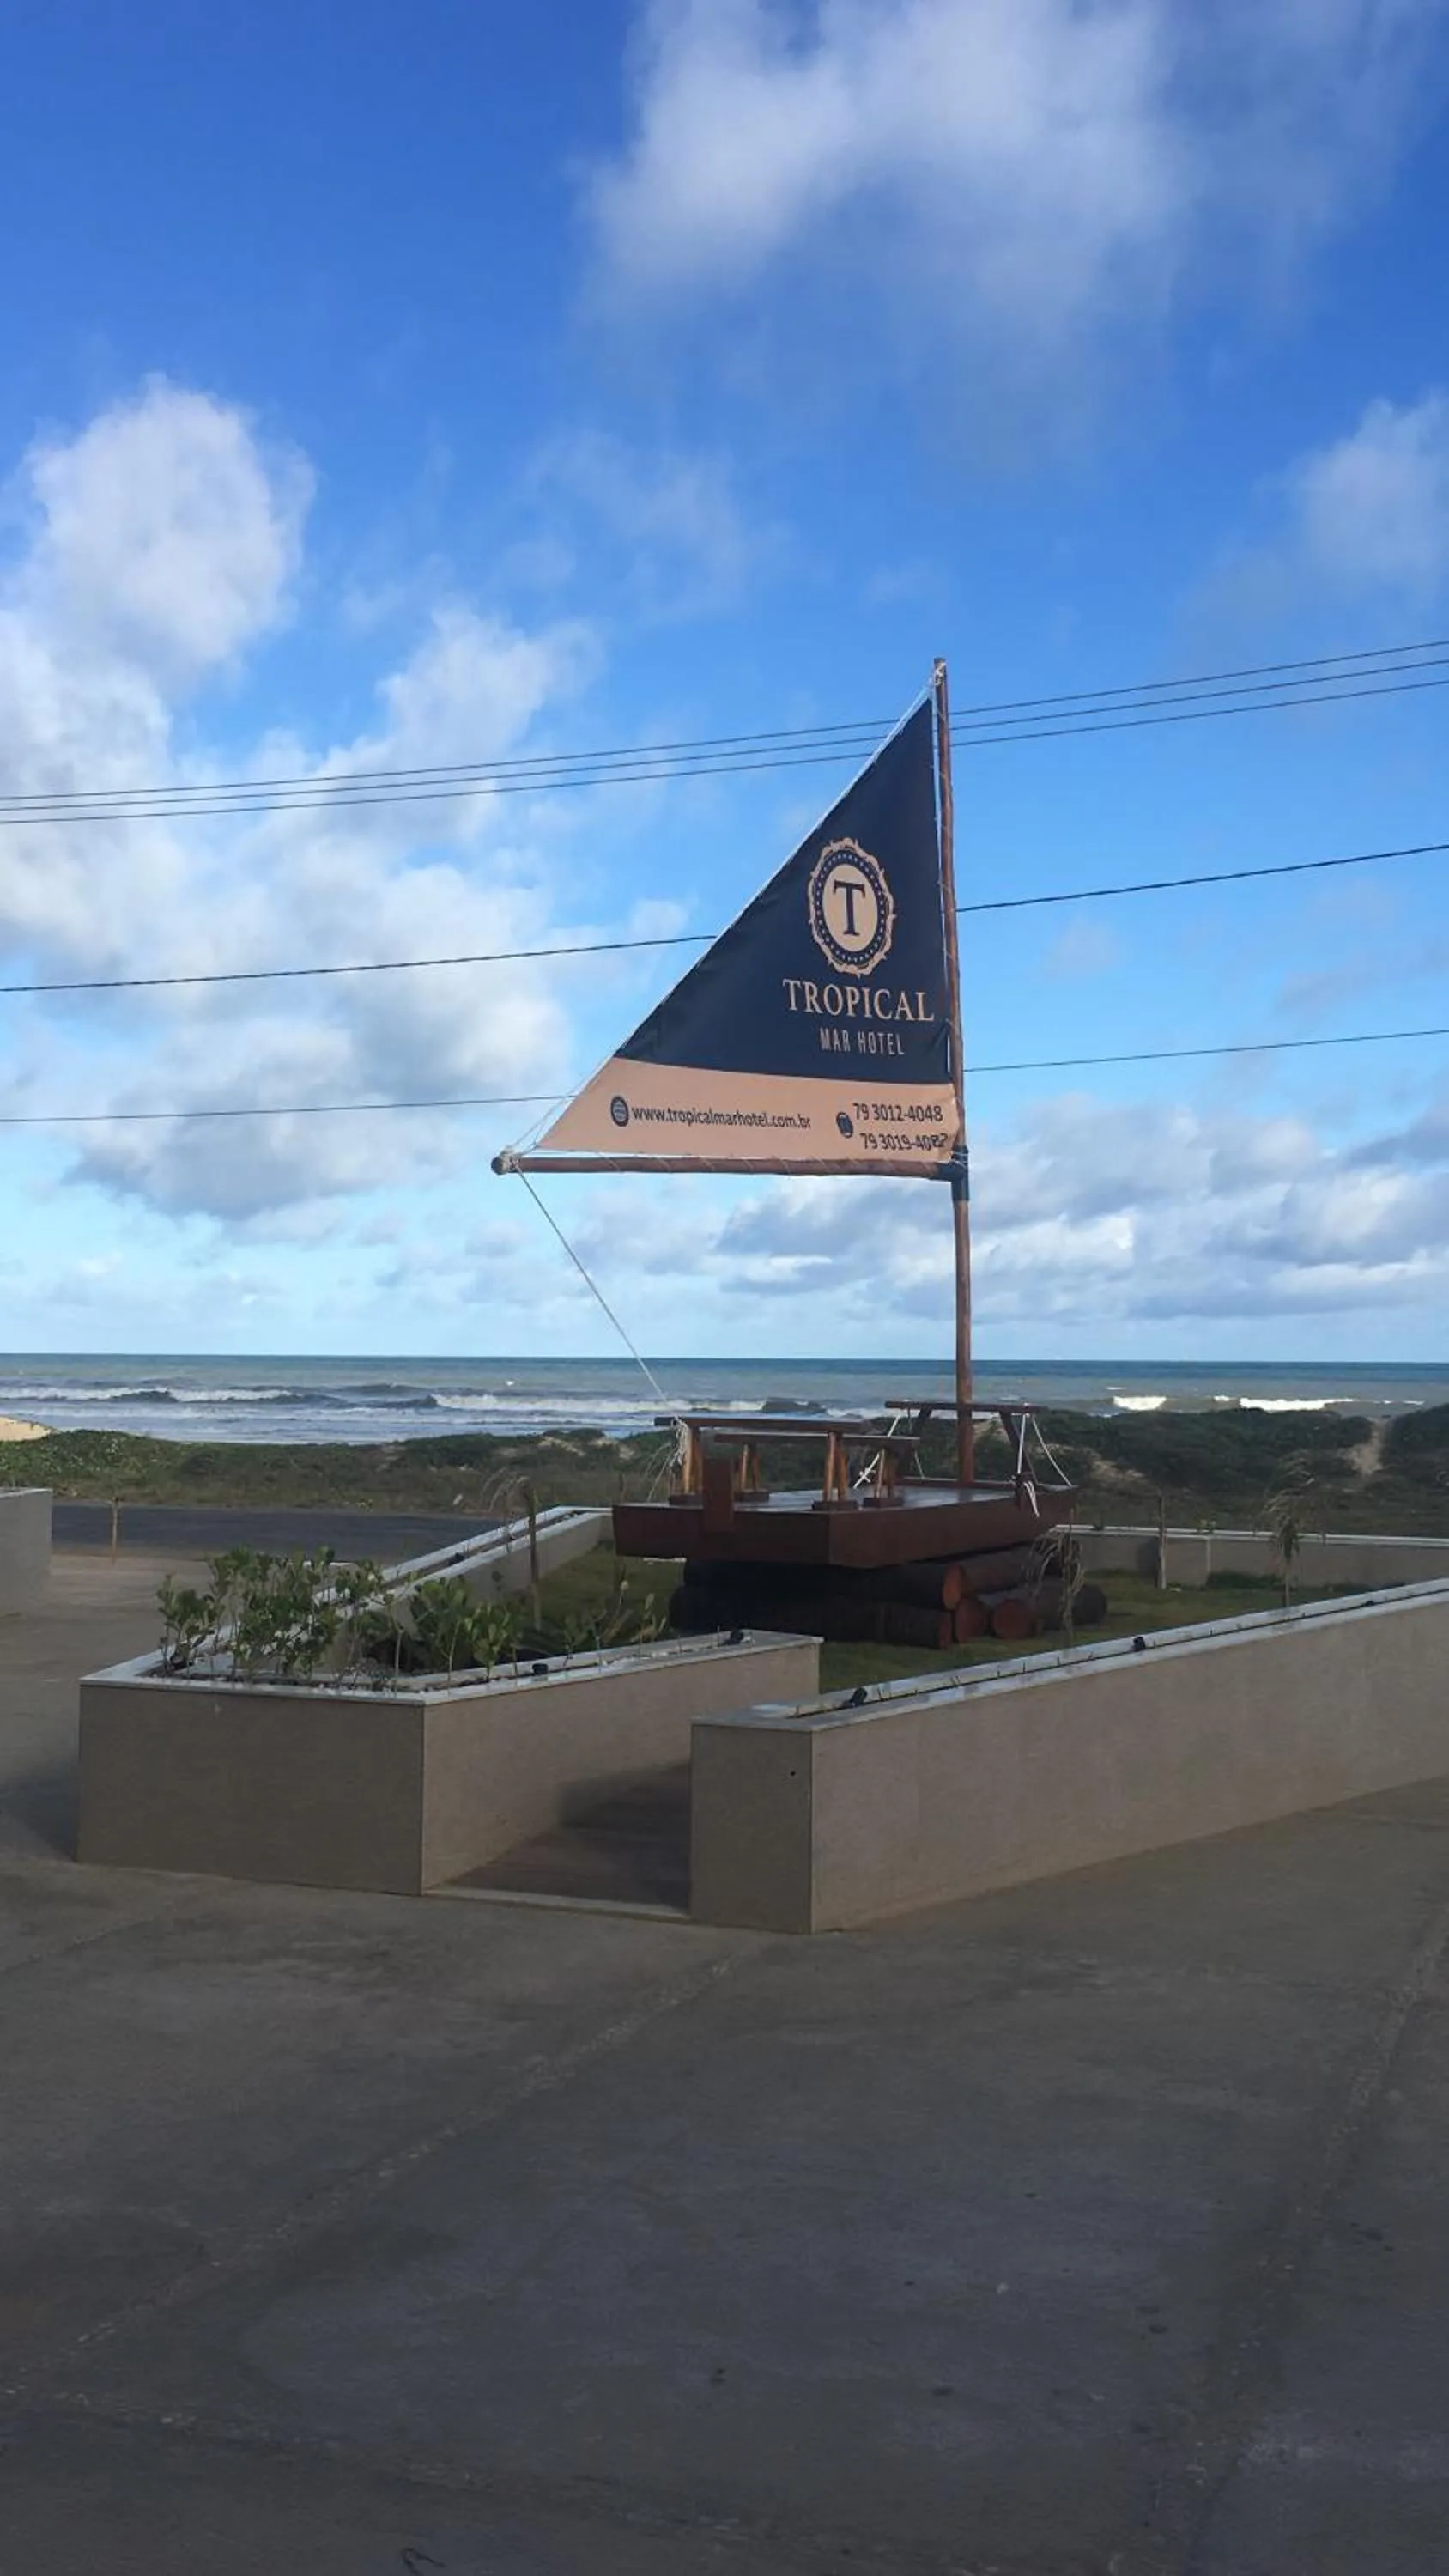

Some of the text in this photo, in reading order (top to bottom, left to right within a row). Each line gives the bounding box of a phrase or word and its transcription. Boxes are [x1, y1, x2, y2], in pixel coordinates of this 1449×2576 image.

[833, 879, 866, 936] T
[783, 979, 935, 1022] TROPICAL
[820, 1027, 905, 1055] MAR HOTEL
[631, 1107, 811, 1129] www.tropicalmarhotel.com.br
[852, 1103, 943, 1122] 79 3012-4048
[860, 1133, 878, 1150] 79
